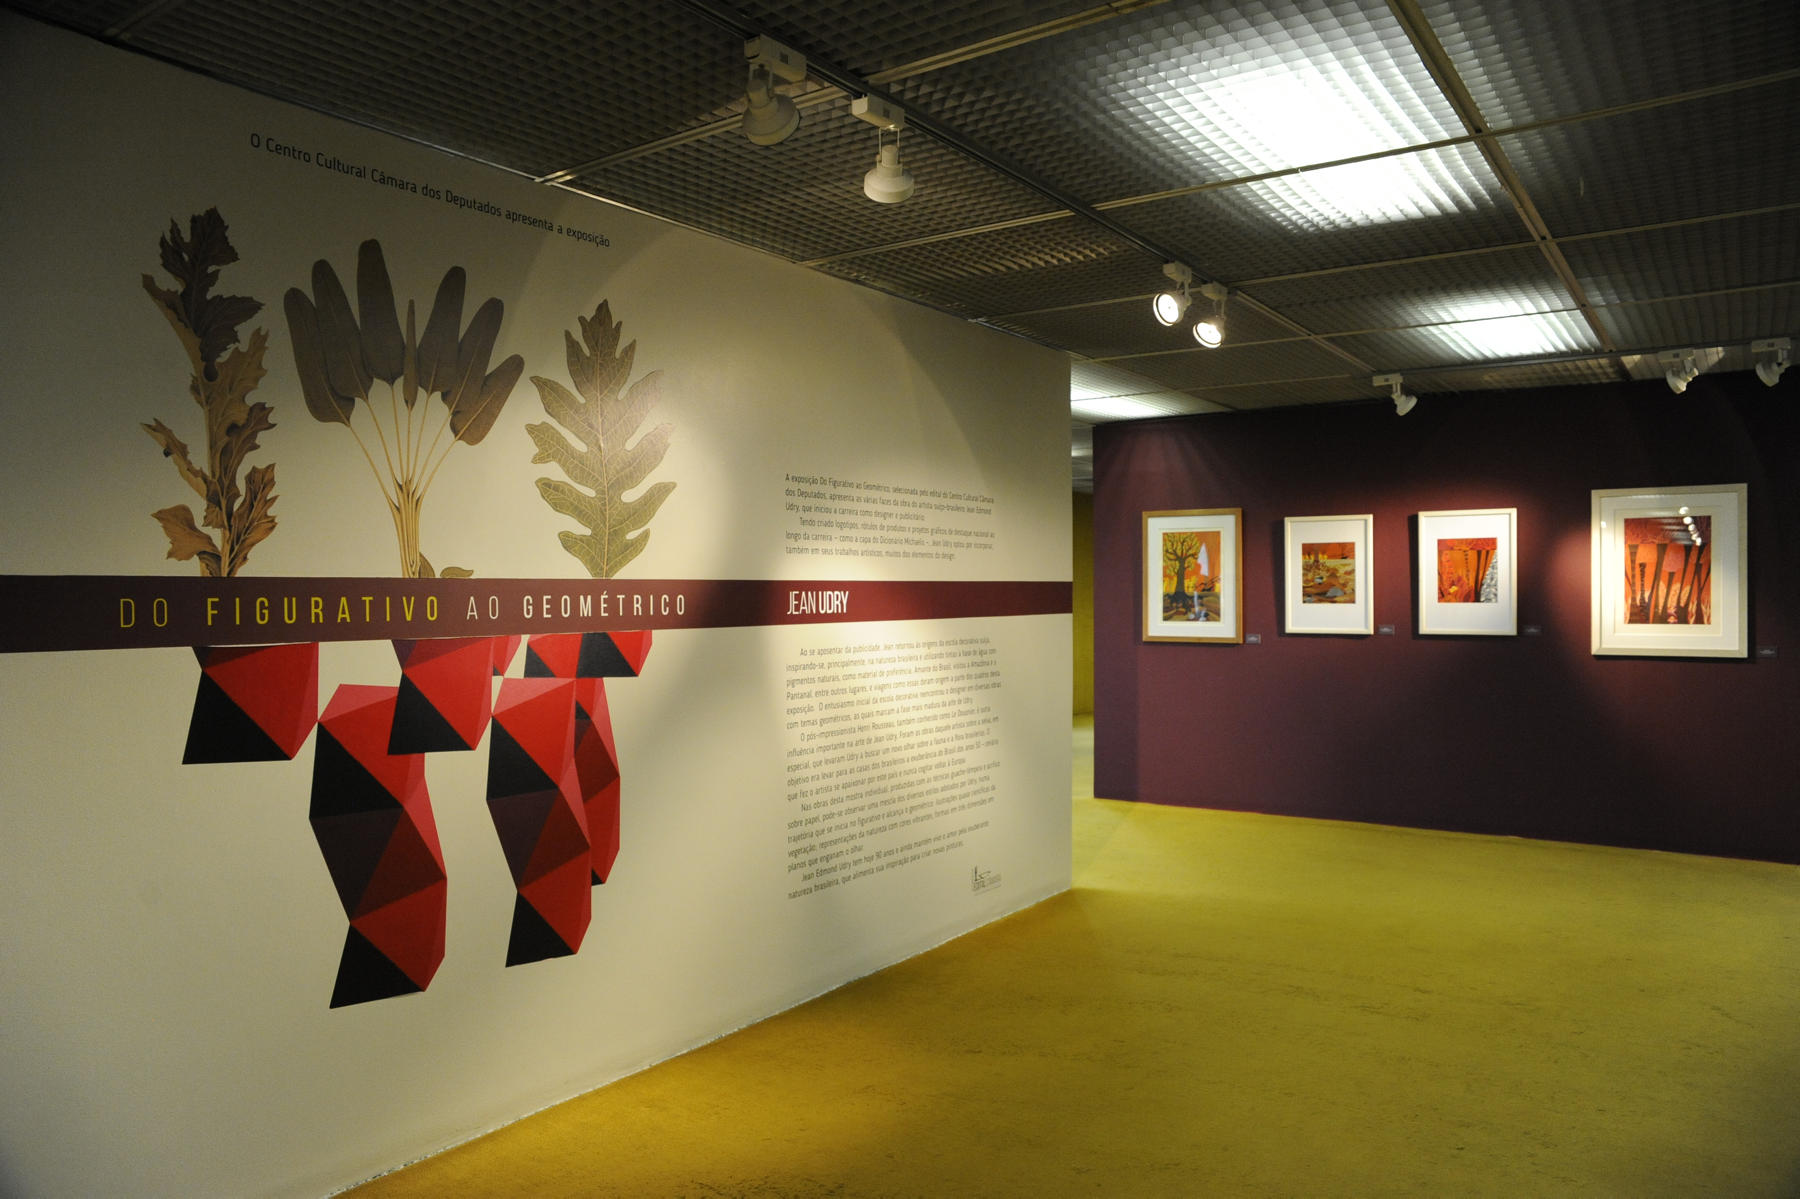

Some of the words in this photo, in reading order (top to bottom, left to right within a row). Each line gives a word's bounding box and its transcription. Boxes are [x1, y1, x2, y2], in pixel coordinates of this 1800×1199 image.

[250, 133, 261, 148] O
[266, 138, 311, 163] Centro
[316, 152, 366, 179] Cultural
[371, 168, 417, 193] Câmara
[422, 184, 441, 200] dos
[445, 190, 502, 217] Deputados
[505, 209, 554, 232] apresenta
[557, 225, 563, 234] a
[566, 227, 610, 247] exposição
[791, 474, 818, 488] exposição
[785, 487, 796, 497] dos
[802, 506, 812, 515] que
[800, 517, 816, 526] Tendo
[786, 531, 801, 542] longo
[803, 532, 810, 540] da
[786, 545, 809, 554] também
[119, 598, 169, 628] DO
[206, 596, 438, 626] FIGURATIVO
[466, 595, 499, 621] AO
[523, 591, 687, 619] GEOMÉTRICO
[786, 591, 817, 616] JEAN
[818, 591, 849, 614] UDRY
[800, 648, 807, 657] Ao
[786, 675, 816, 689] pigmentos
[800, 717, 818, 727] temas
[787, 745, 815, 758] influência
[787, 774, 809, 789] objetivo
[787, 792, 798, 803] que
[799, 788, 808, 798] fez
[801, 801, 812, 812] Nas
[787, 817, 803, 829] sobre
[788, 829, 814, 846] trajetória
[788, 858, 807, 875] planos
[808, 858, 818, 869] que
[801, 870, 814, 882] Jean
[788, 885, 812, 900] natureza
